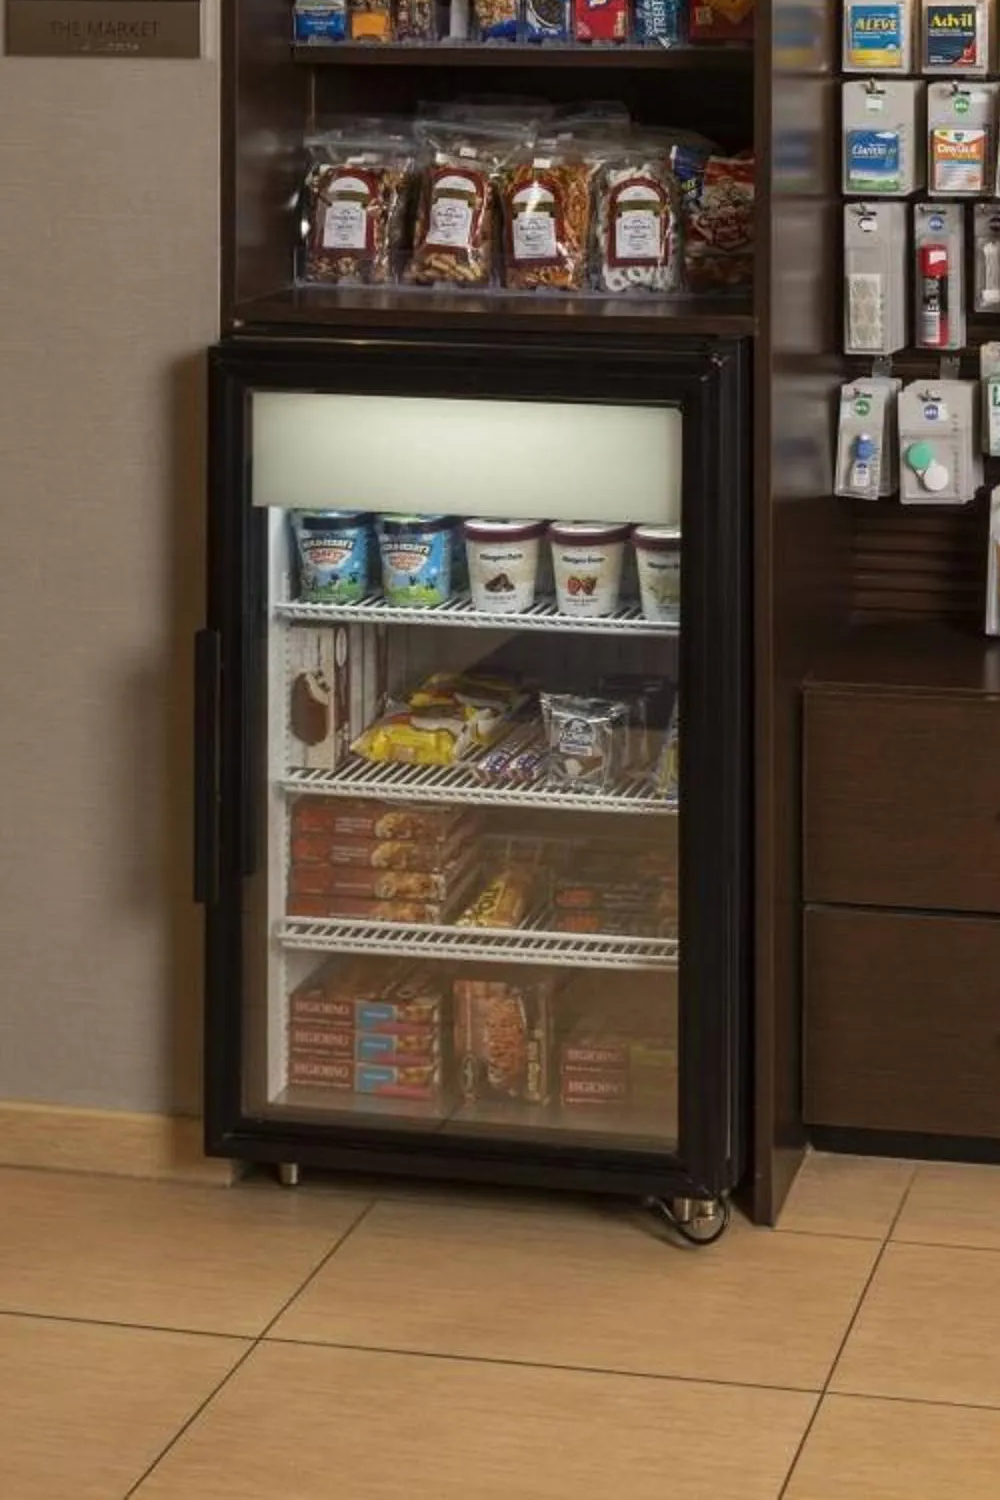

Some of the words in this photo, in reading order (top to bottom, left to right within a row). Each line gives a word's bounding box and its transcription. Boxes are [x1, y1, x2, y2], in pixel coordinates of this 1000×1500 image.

[931, 12, 973, 28] Advil
[51, 21, 80, 37] THE
[87, 21, 161, 37] MARKET
